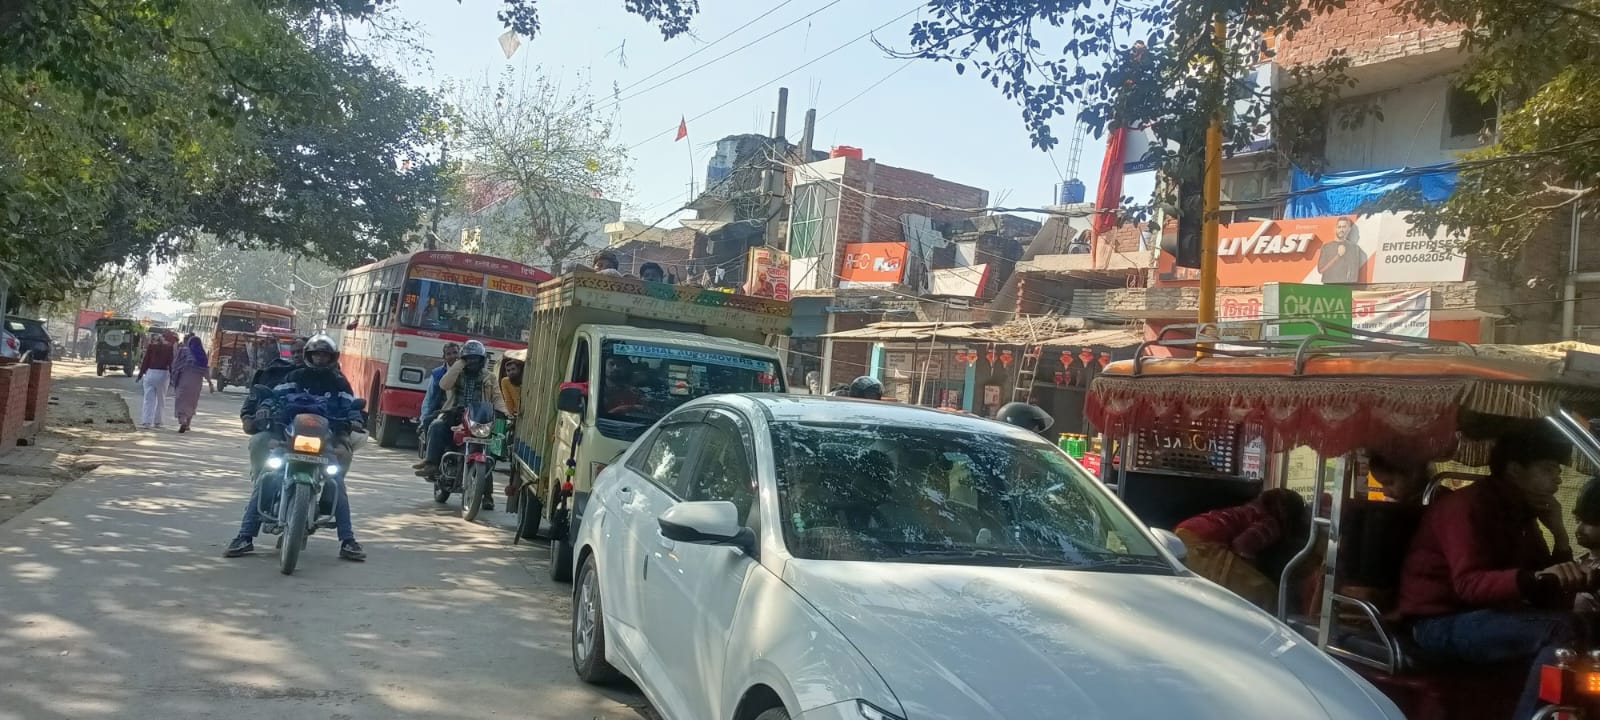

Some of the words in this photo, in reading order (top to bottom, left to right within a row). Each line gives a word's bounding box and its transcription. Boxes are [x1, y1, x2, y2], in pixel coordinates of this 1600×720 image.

[1217, 217, 1314, 256] LIVFAST
[1382, 239, 1465, 252] ENTERPRISES
[1385, 253, 1453, 264] 8090682054
[1284, 295, 1347, 319] OKAYA
[632, 345, 673, 356] VISHAL
